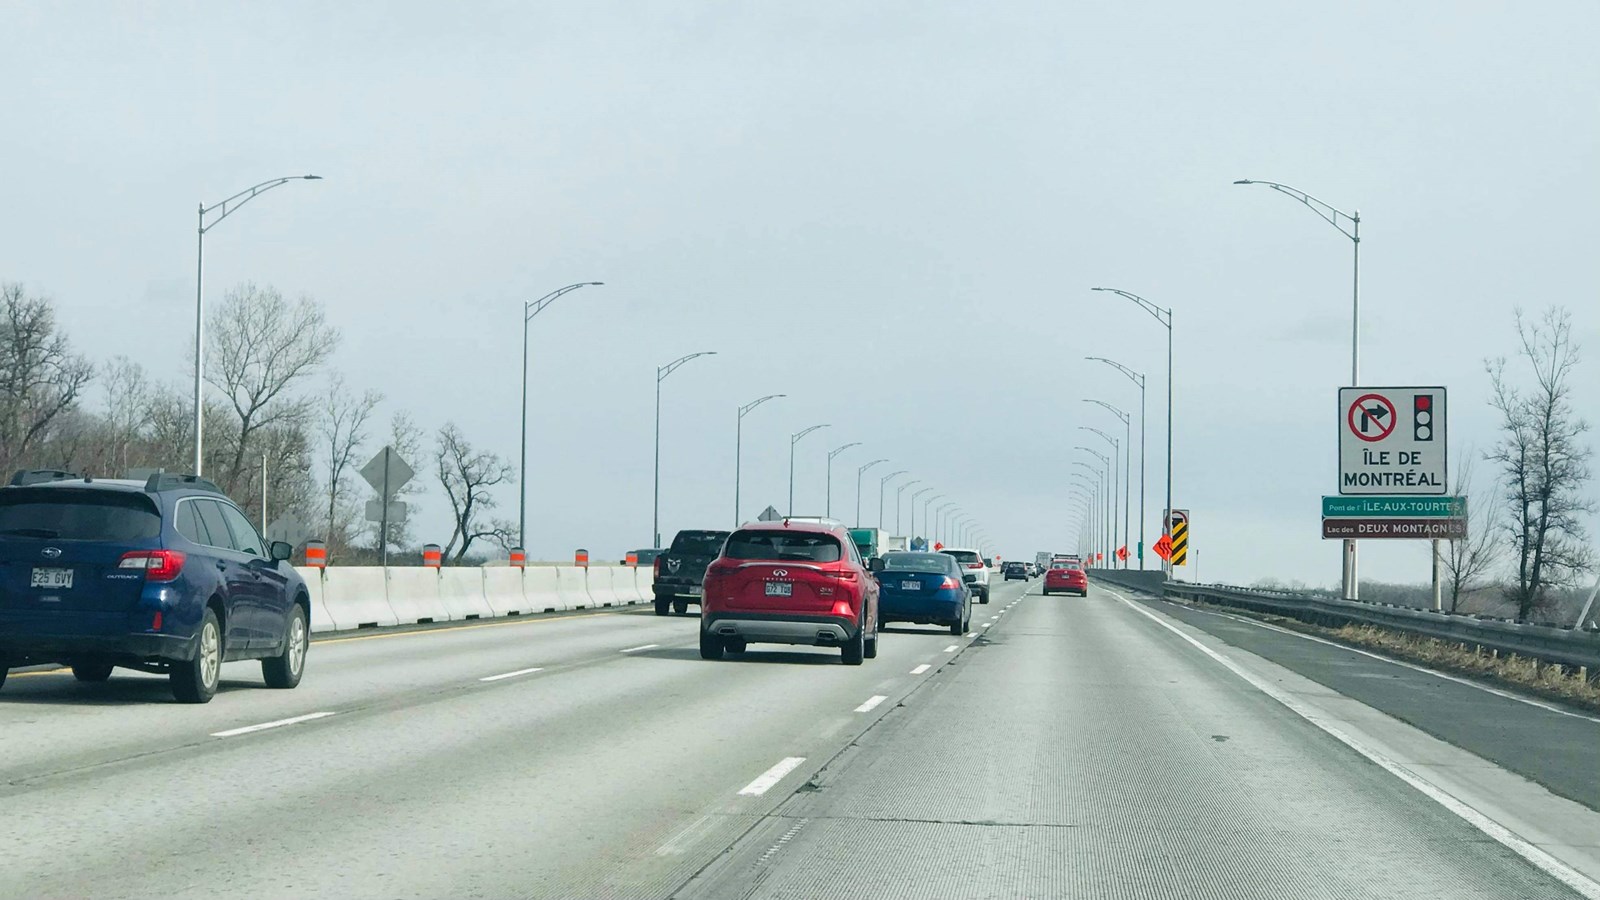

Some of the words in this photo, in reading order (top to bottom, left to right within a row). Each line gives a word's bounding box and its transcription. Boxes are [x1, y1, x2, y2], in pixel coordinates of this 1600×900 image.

[1362, 448, 1390, 465] ÎLE
[1398, 451, 1422, 465] DE
[1344, 469, 1442, 486] MONTRÉAL
[1358, 524, 1389, 533] DEUX
[32, 572, 50, 584] E25
[54, 573, 73, 584] GVY
